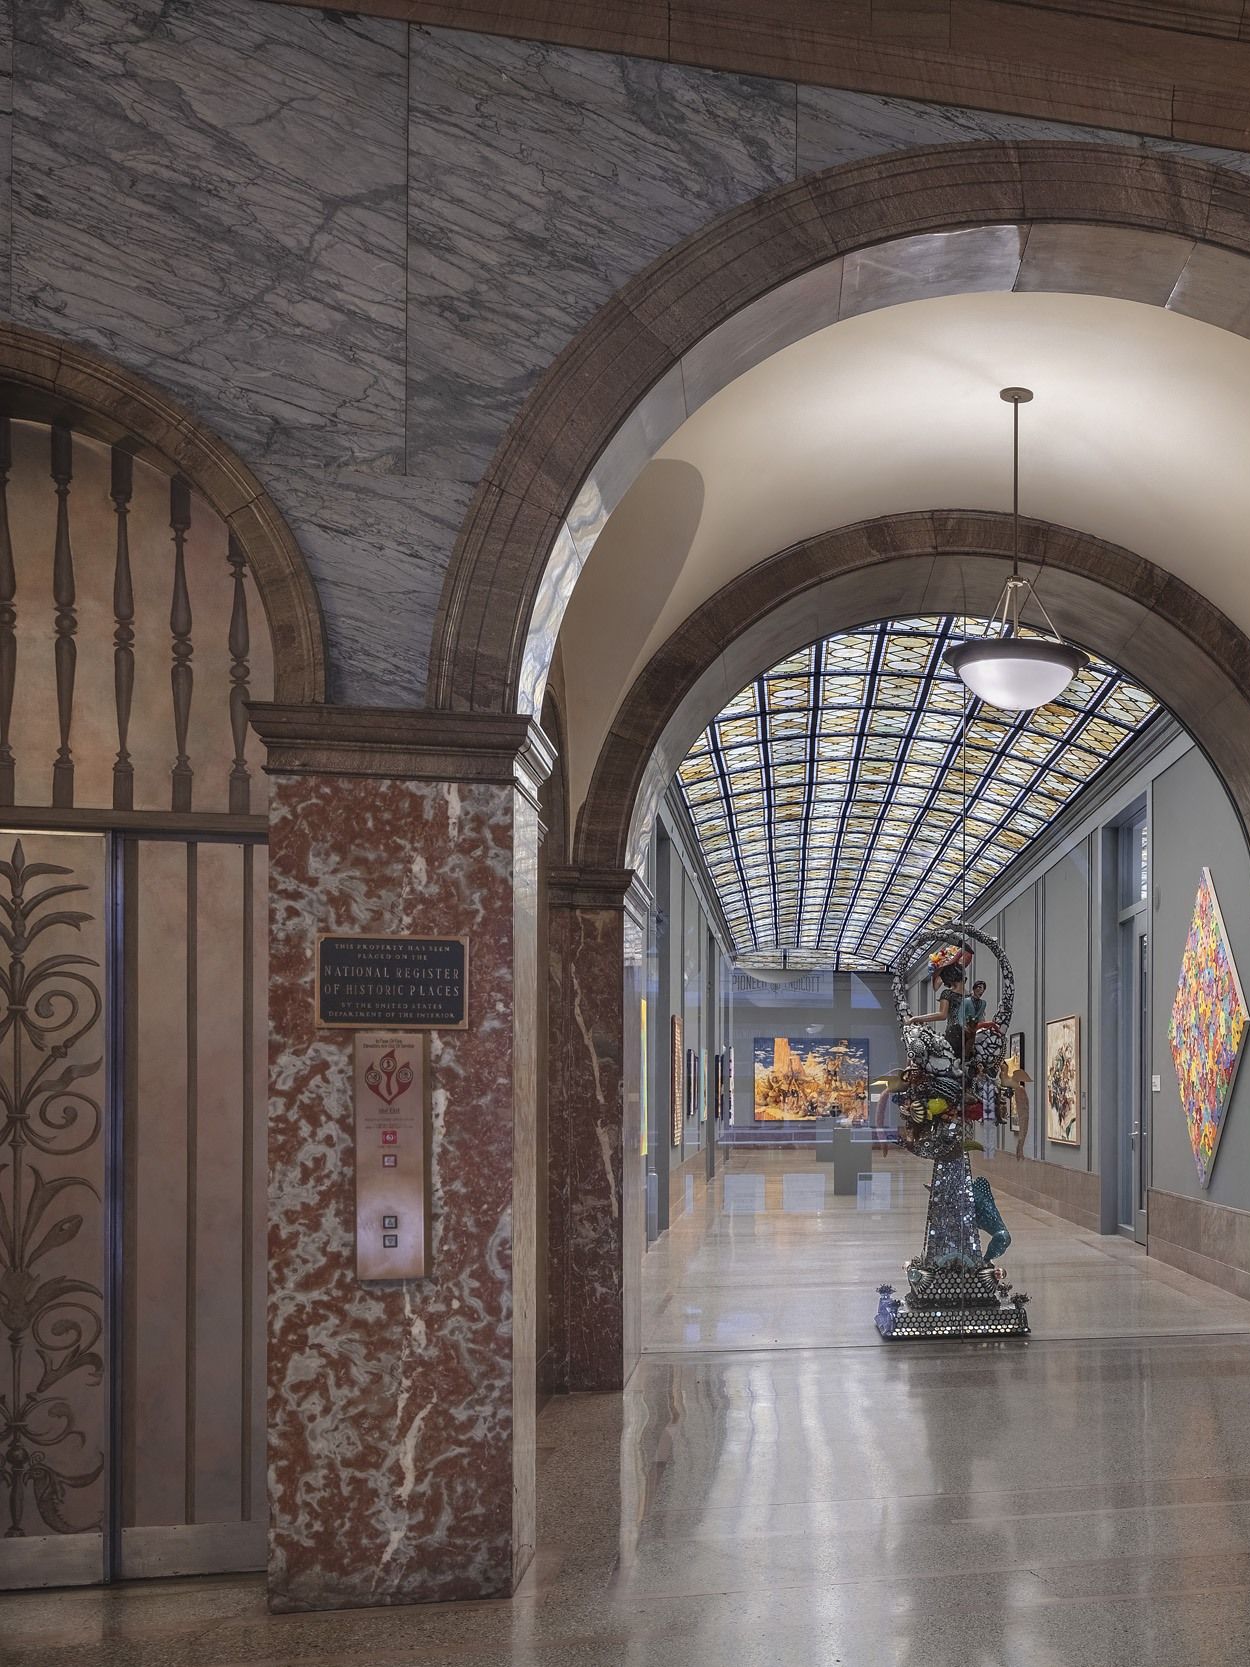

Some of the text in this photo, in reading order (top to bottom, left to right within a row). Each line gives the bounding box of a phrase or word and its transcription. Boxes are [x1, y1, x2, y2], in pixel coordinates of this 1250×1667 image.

[324, 965, 460, 980] NATIONAL REGISTER
[324, 984, 459, 997] OF HISTORIC PLACES
